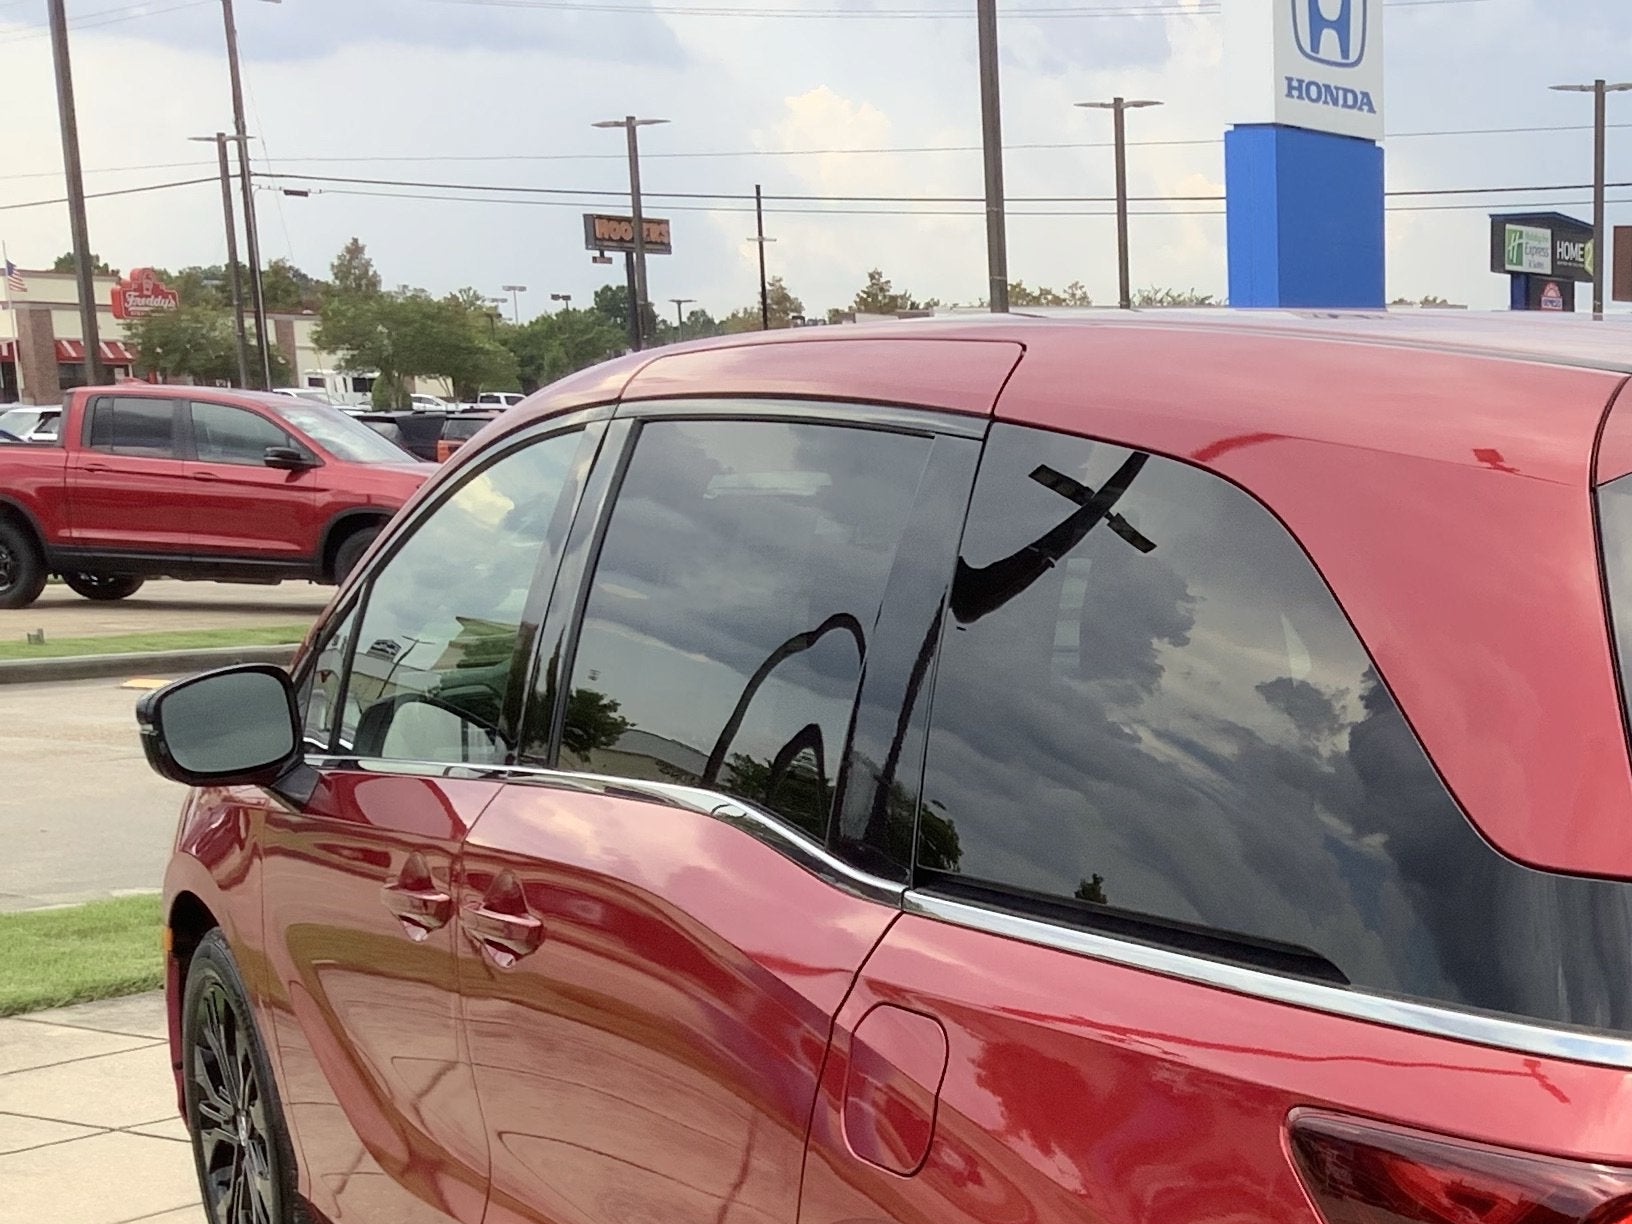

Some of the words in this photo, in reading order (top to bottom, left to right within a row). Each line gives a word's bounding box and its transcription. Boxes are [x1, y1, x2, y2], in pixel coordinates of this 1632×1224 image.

[1284, 76, 1376, 114] HONDA
[594, 218, 670, 243] HOOERS
[1556, 240, 1584, 262] HOME
